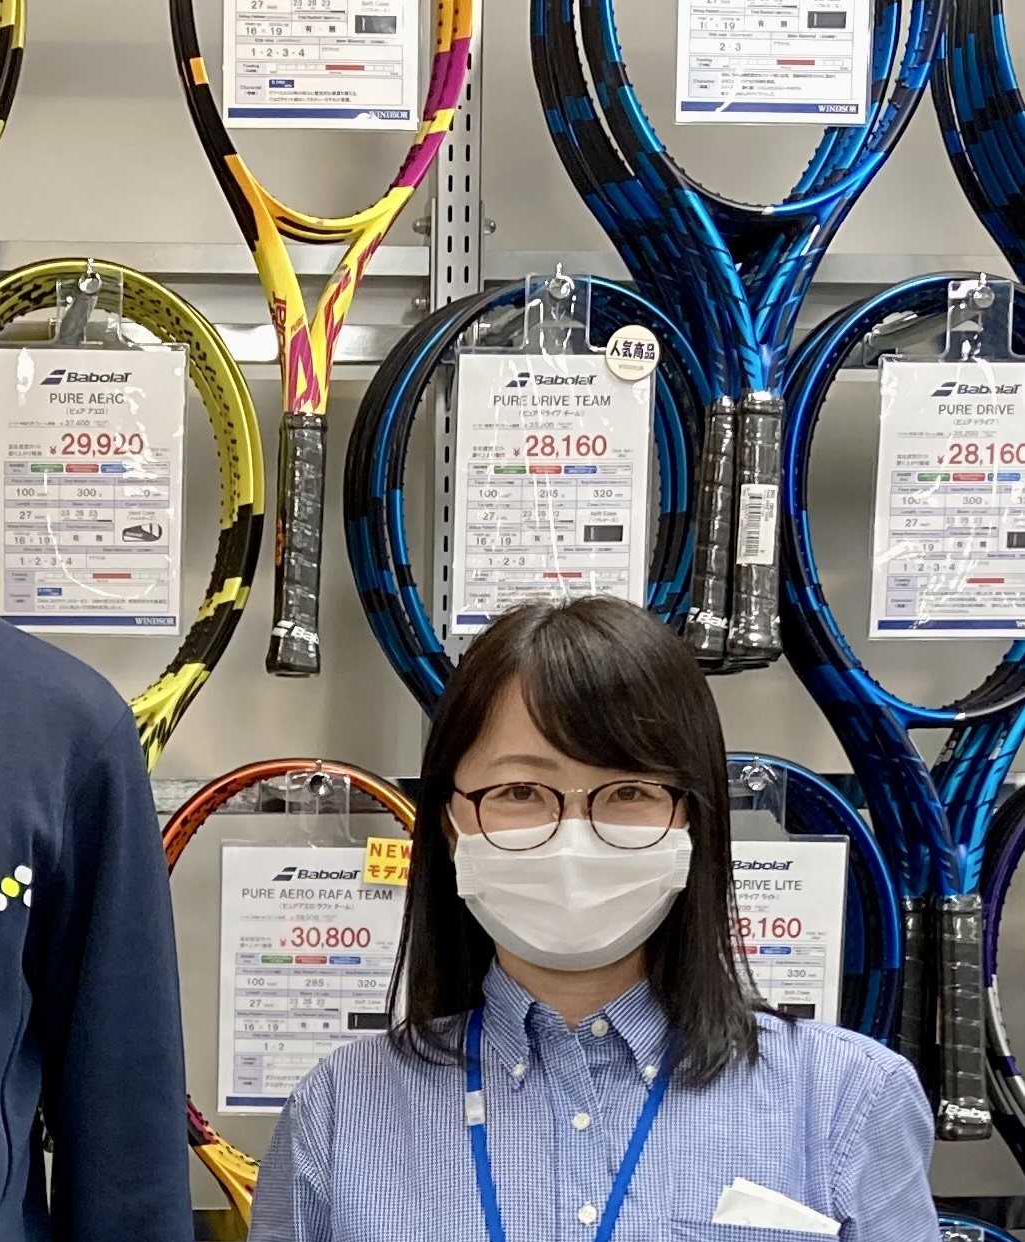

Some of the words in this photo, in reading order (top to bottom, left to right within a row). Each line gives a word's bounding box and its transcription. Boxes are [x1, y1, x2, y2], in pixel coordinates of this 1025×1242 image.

[724, 22, 735, 30] 19
[245, 27, 257, 35] 16
[271, 27, 282, 35] 19
[609, 339, 656, 360] 人気商品
[66, 372, 133, 383] Babolat
[49, 393, 85, 404] PURE
[531, 395, 570, 406] DRIVE
[574, 395, 611, 406] TEAM
[938, 404, 973, 415] PURE
[976, 404, 1015, 415] DRIVE
[61, 433, 144, 457] 29,920
[525, 435, 607, 460] 28,160
[16, 488, 35, 497] 100
[77, 488, 96, 497] 300
[593, 490, 613, 498] 320
[963, 497, 982, 505] 300
[19, 511, 32, 519] 27
[482, 512, 495, 521] 27
[905, 519, 918, 527] 27
[14, 536, 25, 545] 16
[38, 536, 51, 545] 19
[476, 537, 487, 546] 16
[135, 617, 175, 625] WINDSOR
[297, 869, 361, 880] Babolat
[734, 880, 771, 891] DRIVE
[775, 880, 803, 891] LITE
[242, 888, 274, 899] PURE
[279, 888, 314, 899] AERO
[319, 888, 352, 900] RAFA
[357, 889, 393, 900] TEAM
[737, 917, 802, 939] 8,160
[291, 926, 371, 949] 30,800
[787, 969, 806, 977] 330
[247, 978, 265, 986] 100
[305, 978, 324, 987] 285
[357, 980, 377, 988] 320
[249, 1000, 262, 1008] 27
[244, 1023, 255, 1031] 16
[267, 1023, 279, 1031] 19
